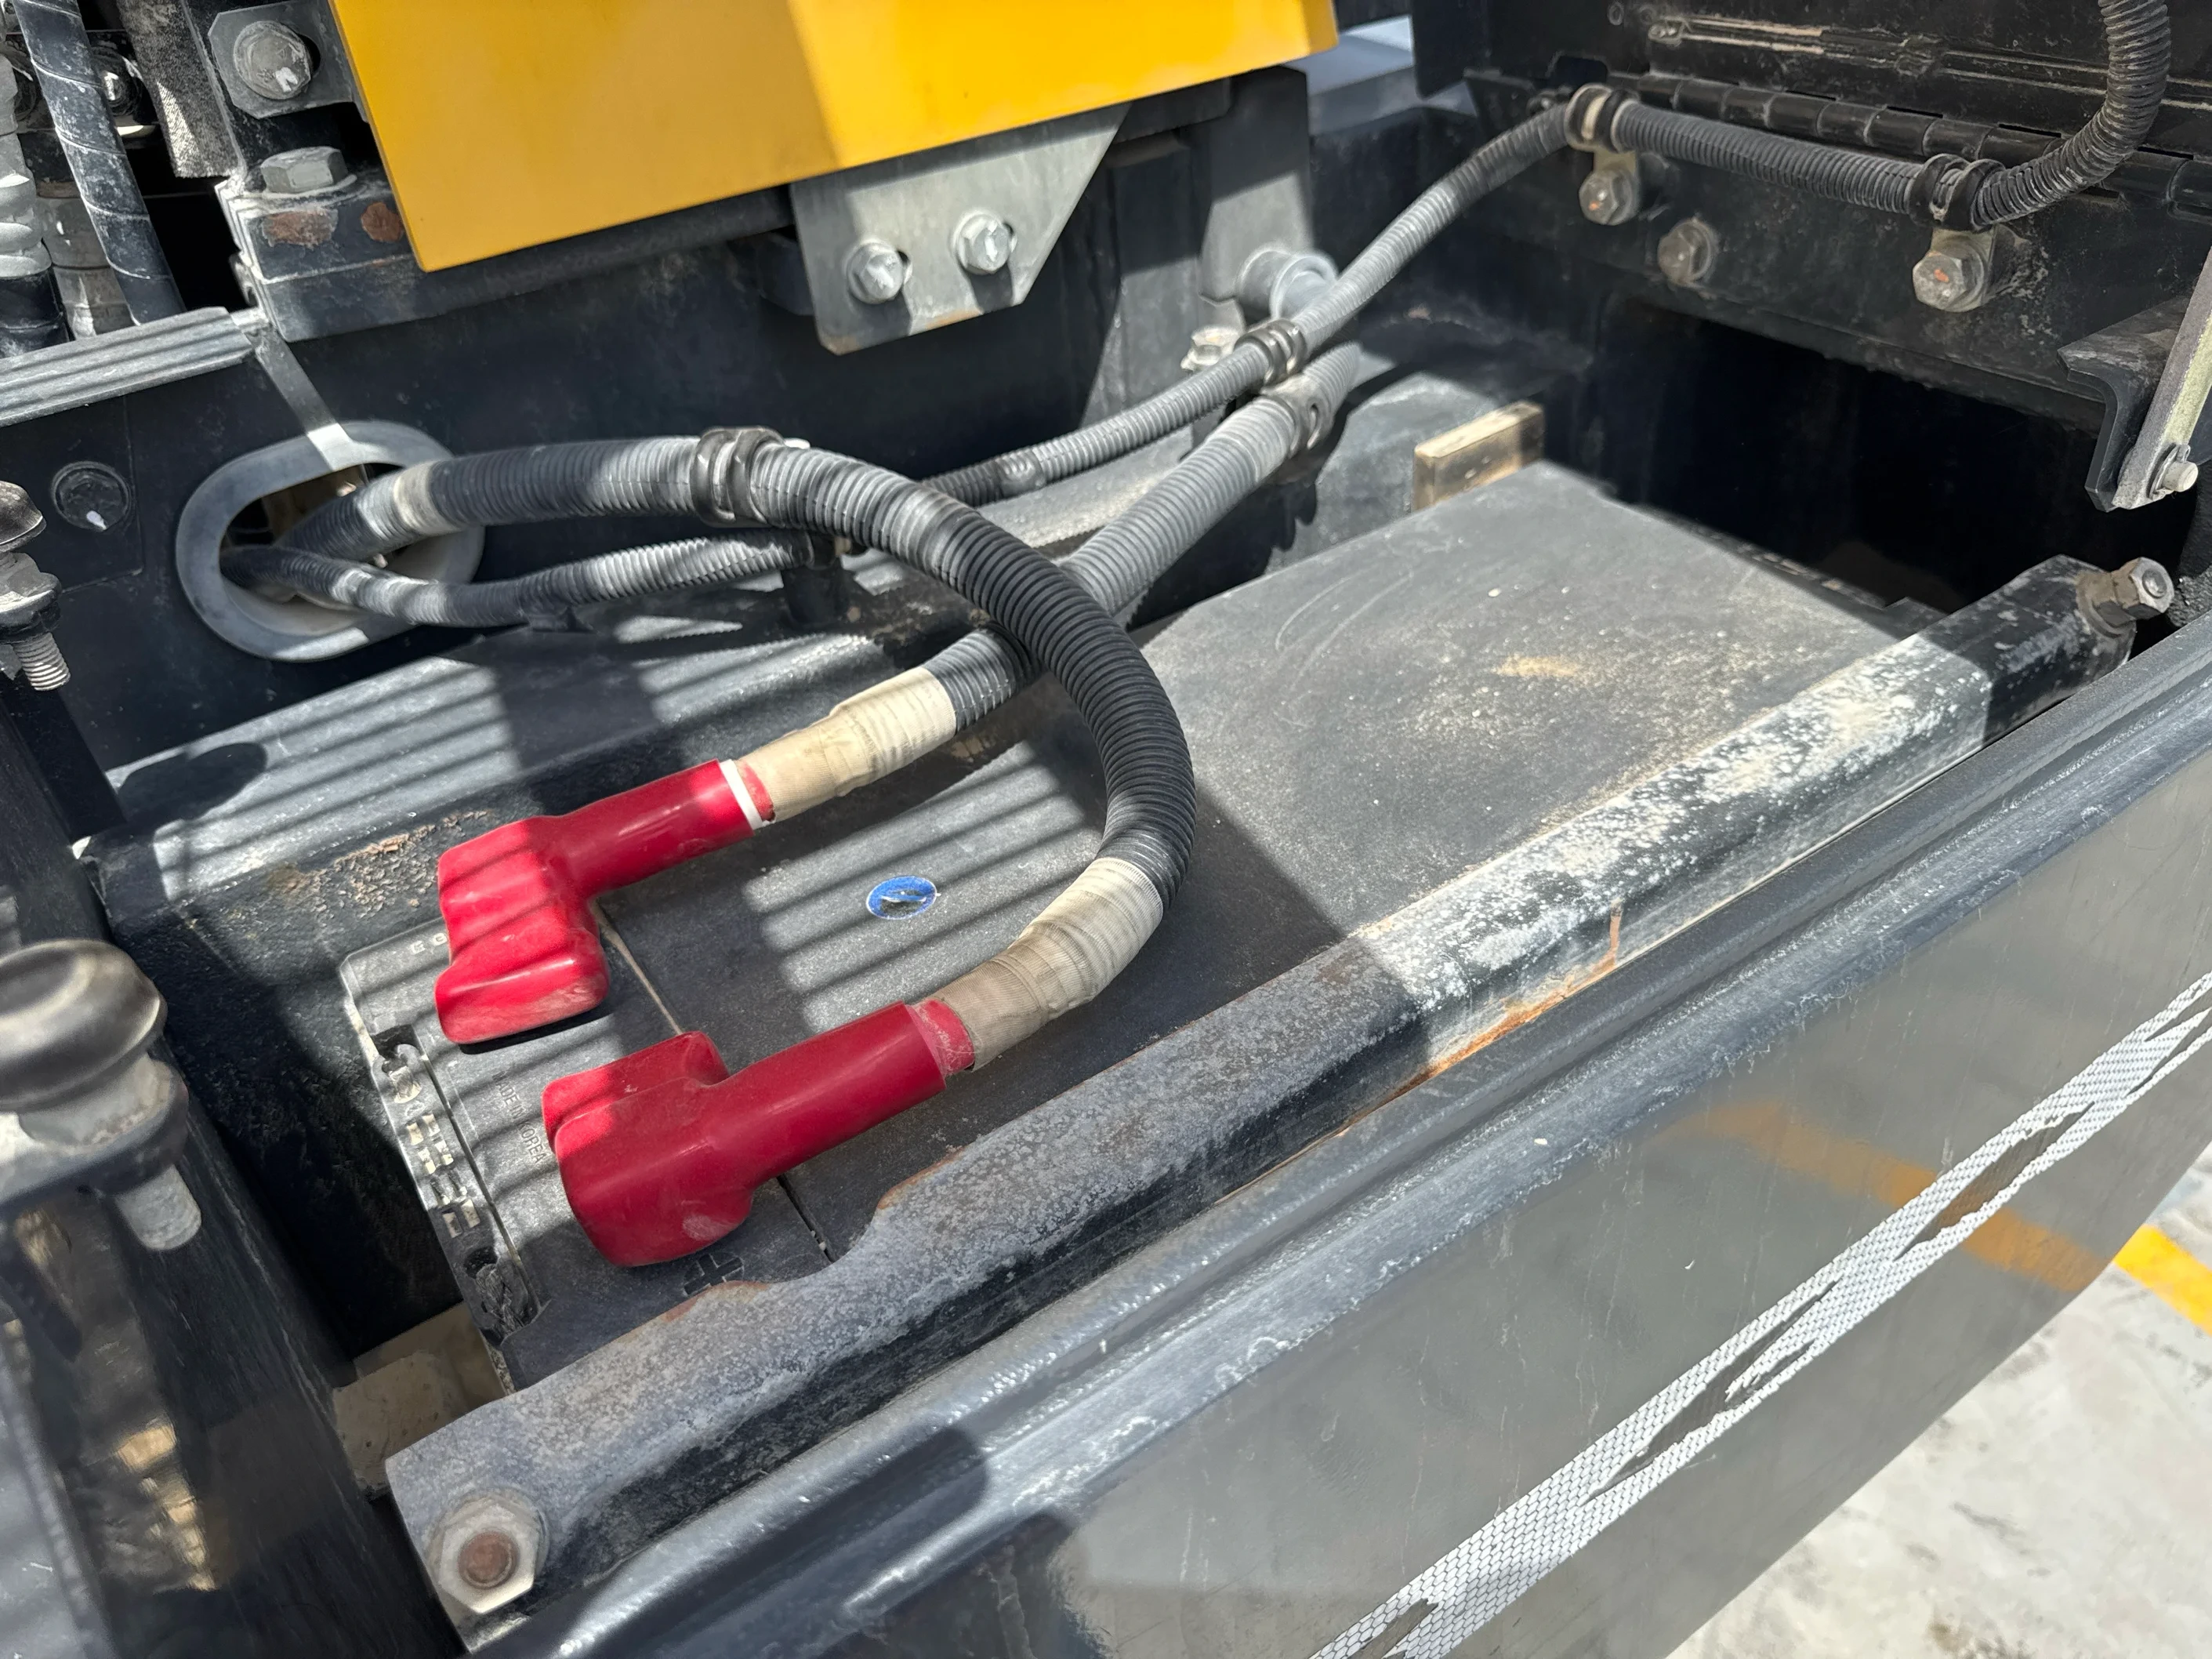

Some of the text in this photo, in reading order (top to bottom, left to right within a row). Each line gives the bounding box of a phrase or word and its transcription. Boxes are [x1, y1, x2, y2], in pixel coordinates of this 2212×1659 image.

[491, 1071, 547, 1163] MADE IN KOREA
